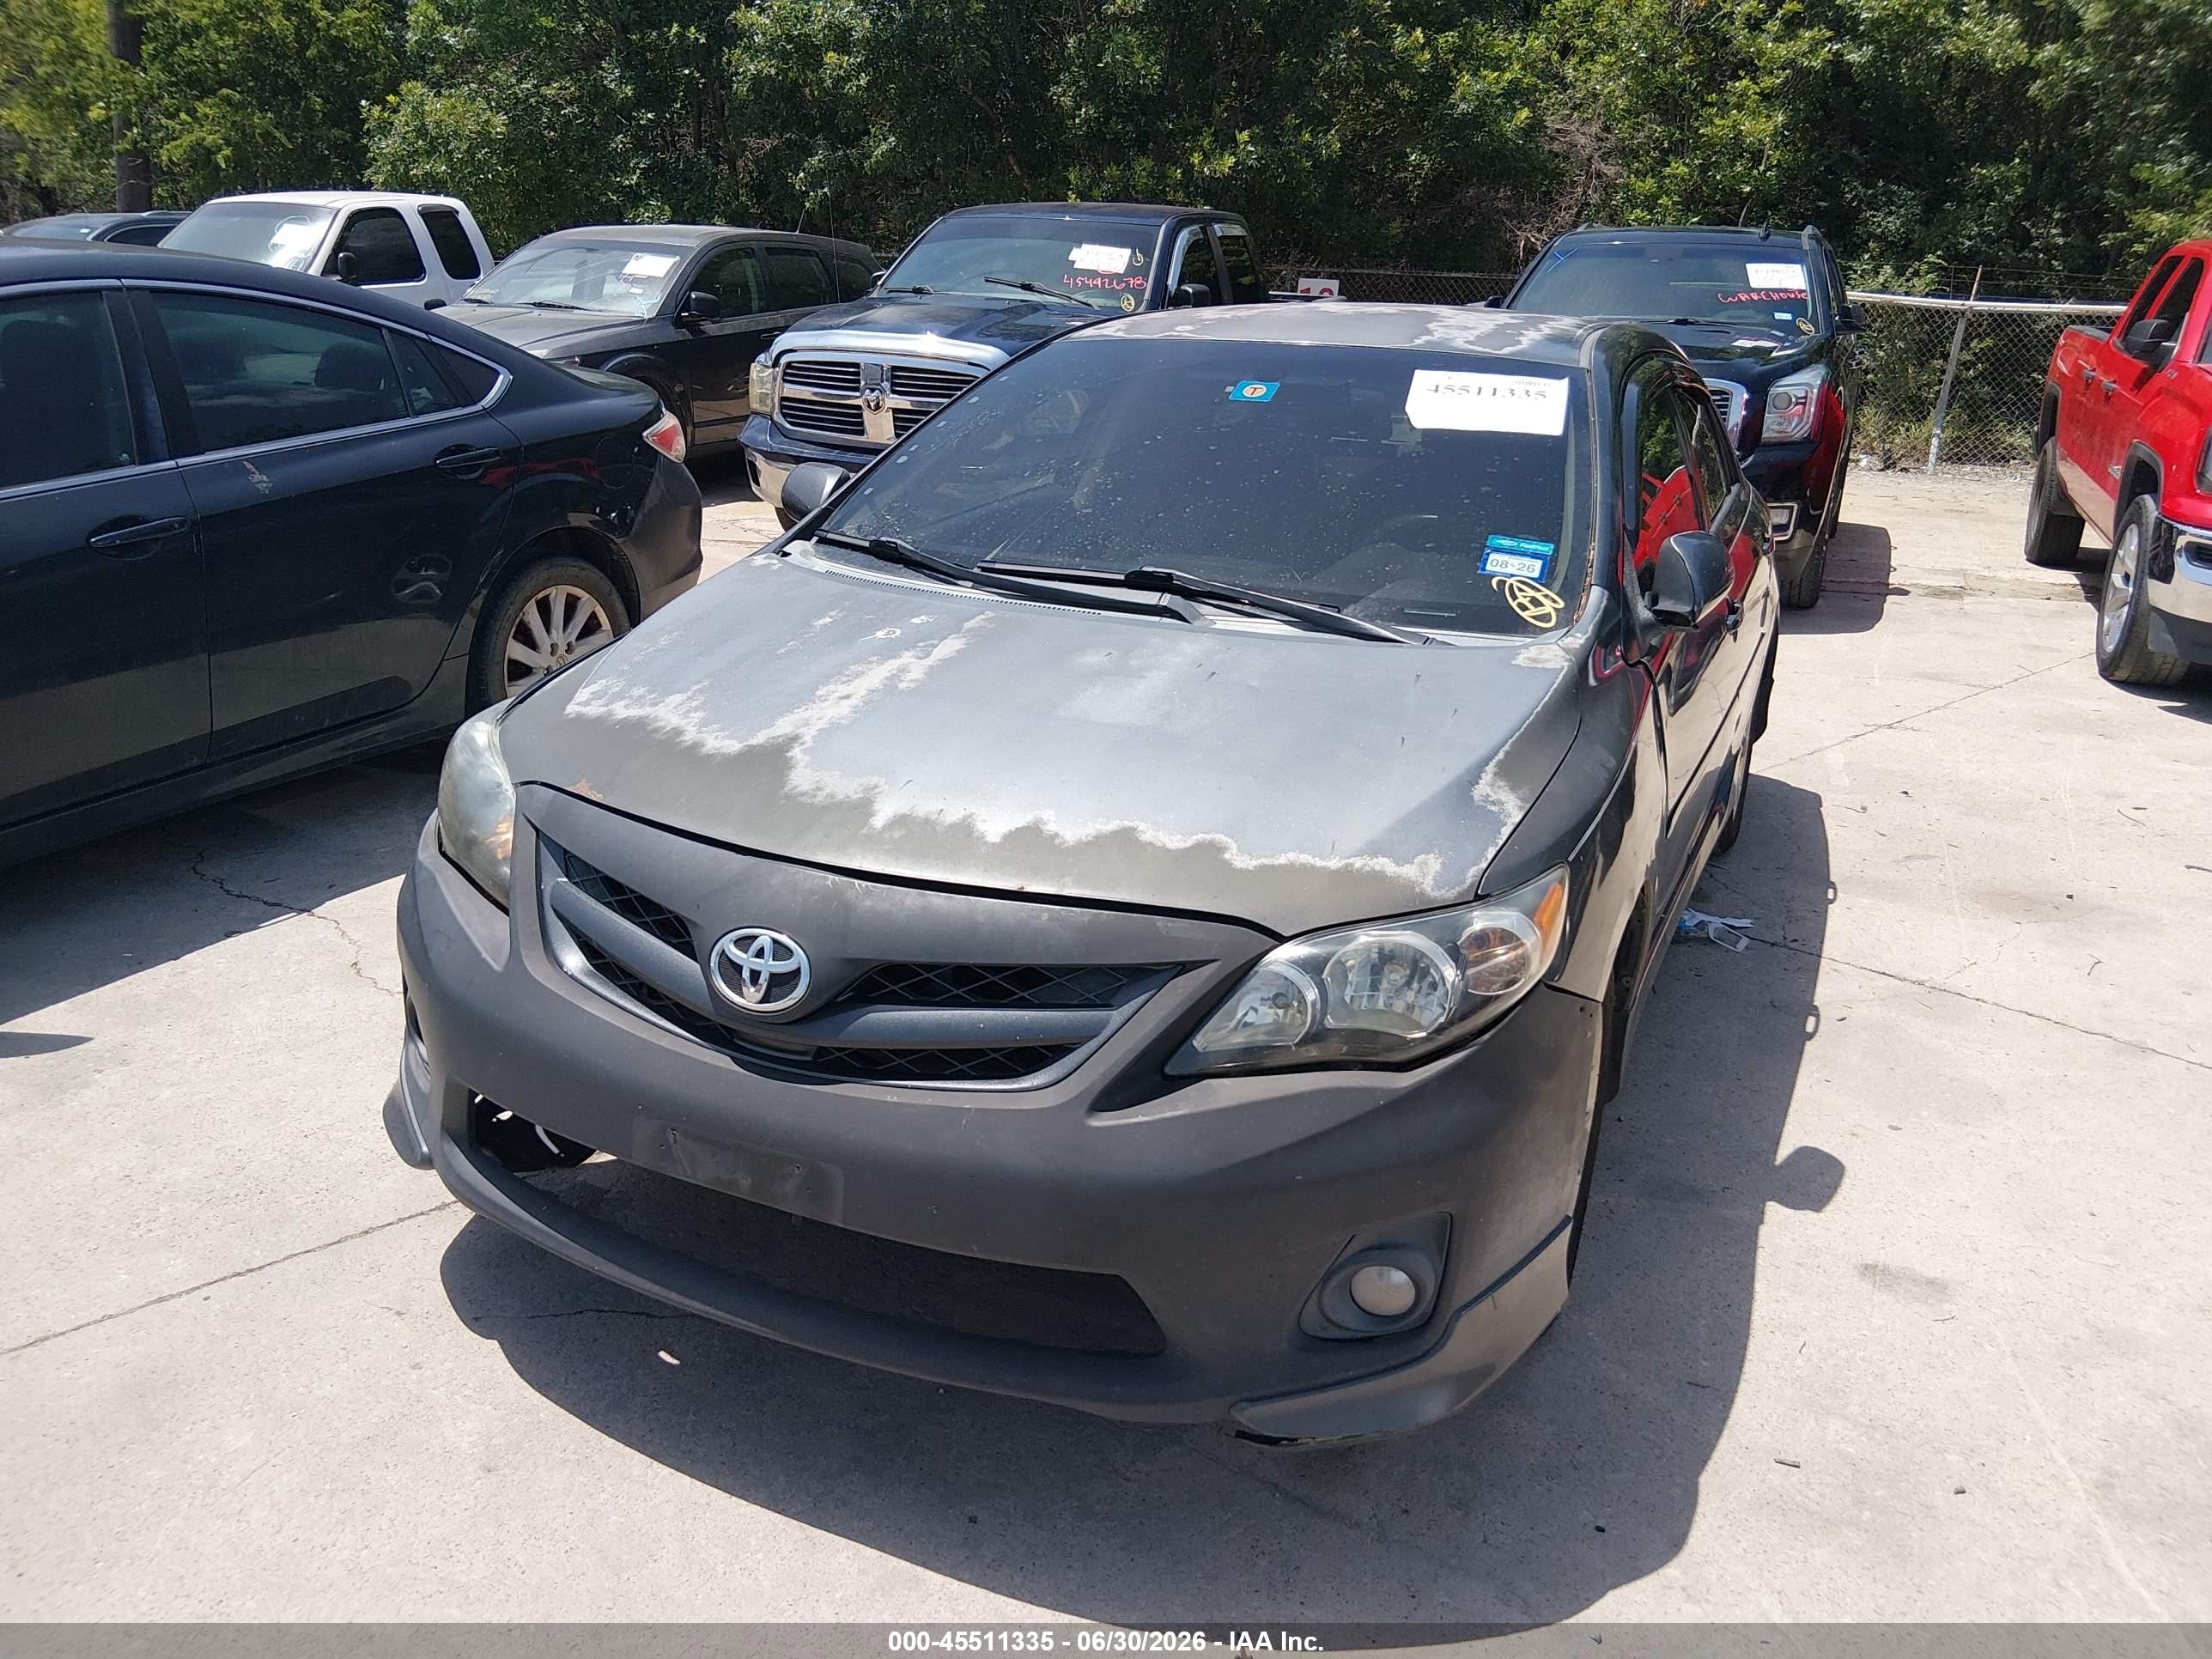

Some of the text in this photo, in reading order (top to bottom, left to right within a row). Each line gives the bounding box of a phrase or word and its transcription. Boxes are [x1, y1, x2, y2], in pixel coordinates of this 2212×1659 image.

[1063, 274, 1147, 289] 45492678
[1250, 386, 1264, 396] T
[1427, 384, 1547, 400] 45511335
